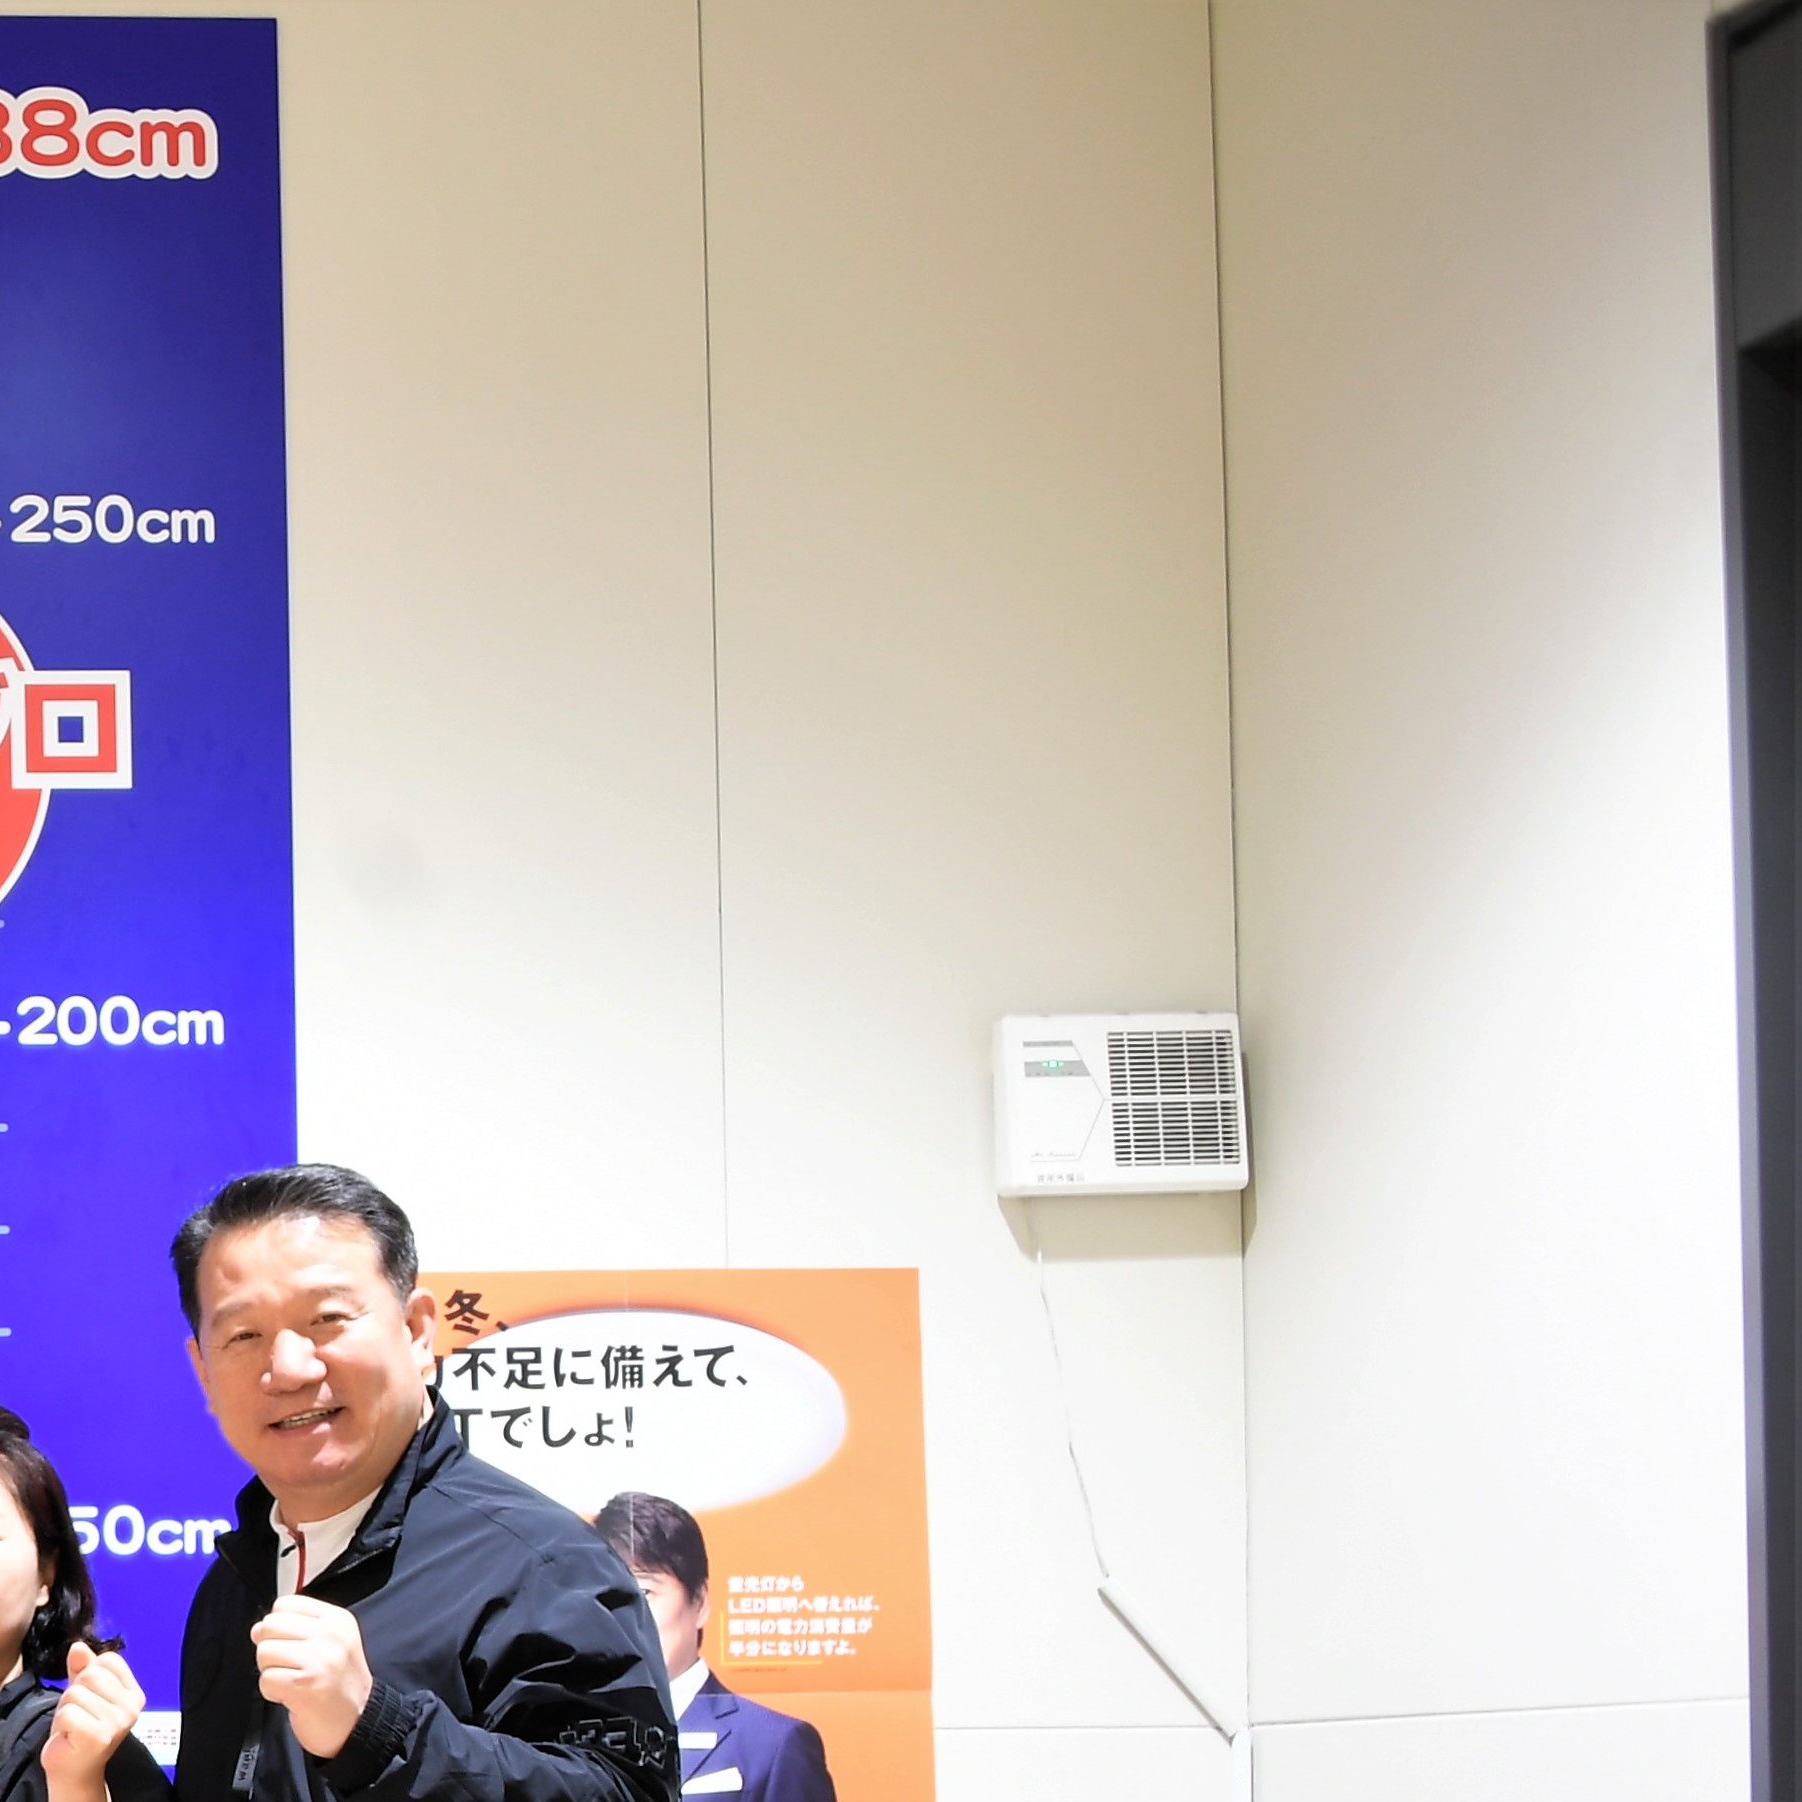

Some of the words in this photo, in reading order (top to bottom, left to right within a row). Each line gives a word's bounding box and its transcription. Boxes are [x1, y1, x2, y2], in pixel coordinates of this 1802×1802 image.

[10, 494, 216, 544] 250cm
[15, 995, 225, 1046] 200cm
[69, 1503, 232, 1556] 50cm
